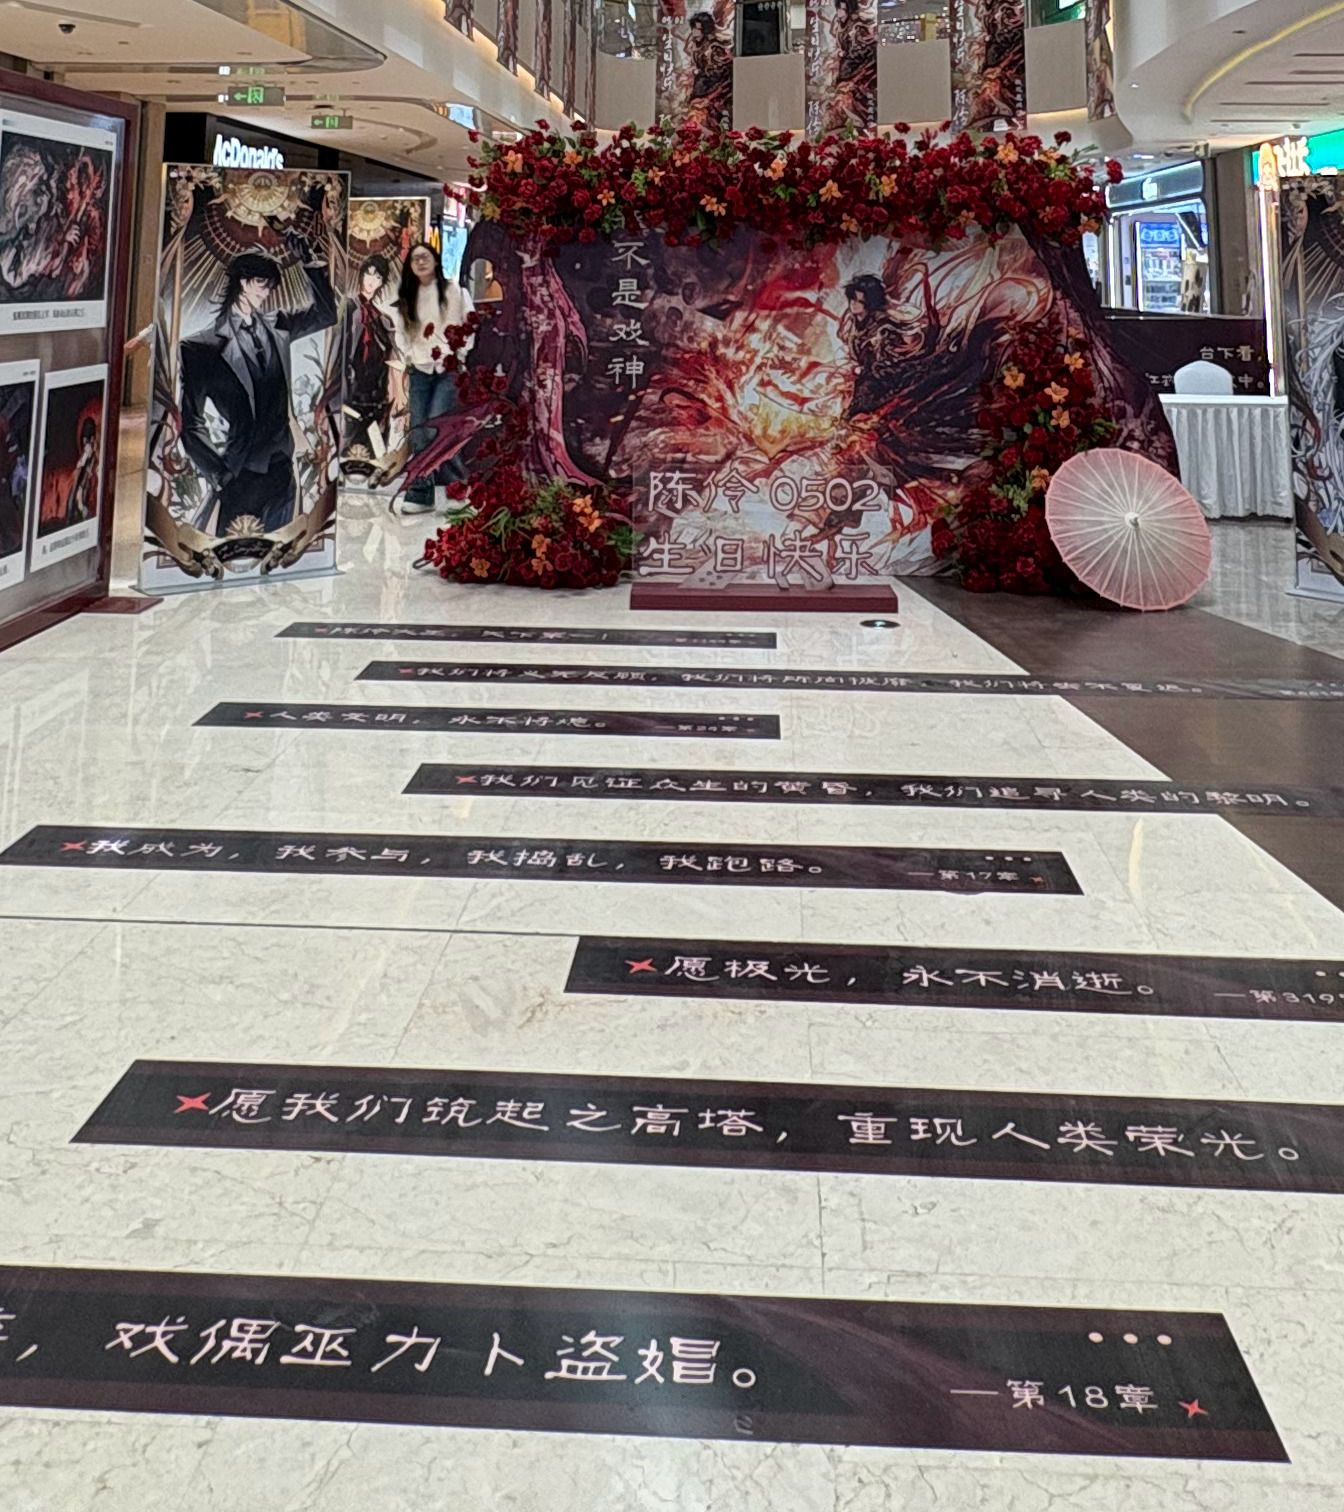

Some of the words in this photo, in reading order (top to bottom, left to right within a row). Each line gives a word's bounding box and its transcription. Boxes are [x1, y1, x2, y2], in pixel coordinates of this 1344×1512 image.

[647, 470, 757, 514] 陈伶
[770, 476, 883, 514] 0502
[638, 530, 880, 583] 生日快乐
[208, 1088, 1301, 1162] 愿我们筑起之高塔，重现人类荣光。
